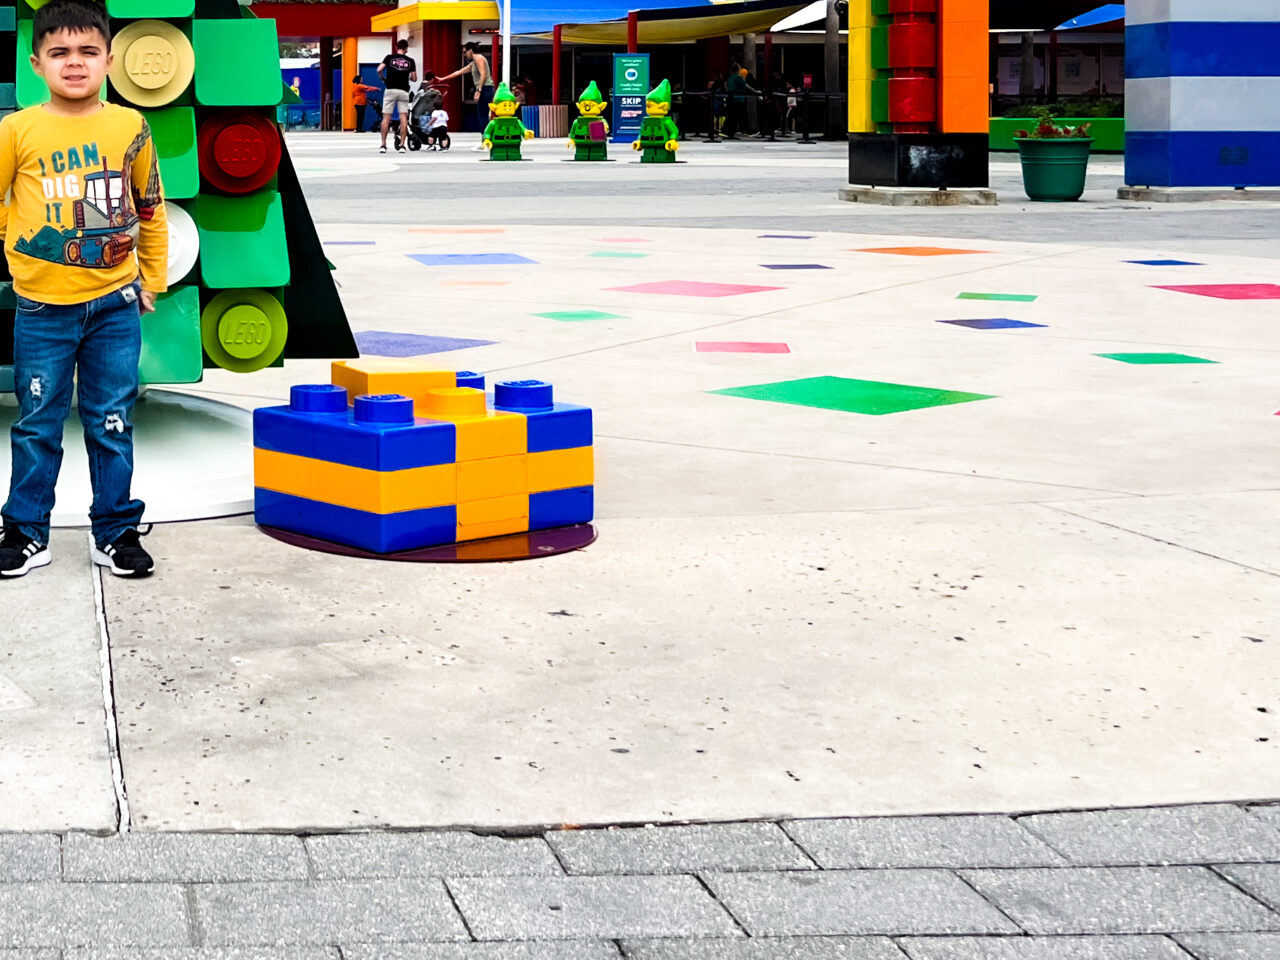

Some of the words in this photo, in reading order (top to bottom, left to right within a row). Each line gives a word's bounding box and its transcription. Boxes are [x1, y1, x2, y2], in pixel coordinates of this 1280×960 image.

[131, 51, 174, 76] LEGO
[621, 97, 642, 105] SKIP
[38, 157, 47, 177] I
[51, 142, 100, 174] CAN
[41, 174, 81, 200] DIG
[45, 202, 63, 224] IT
[224, 320, 267, 345] LEGO
